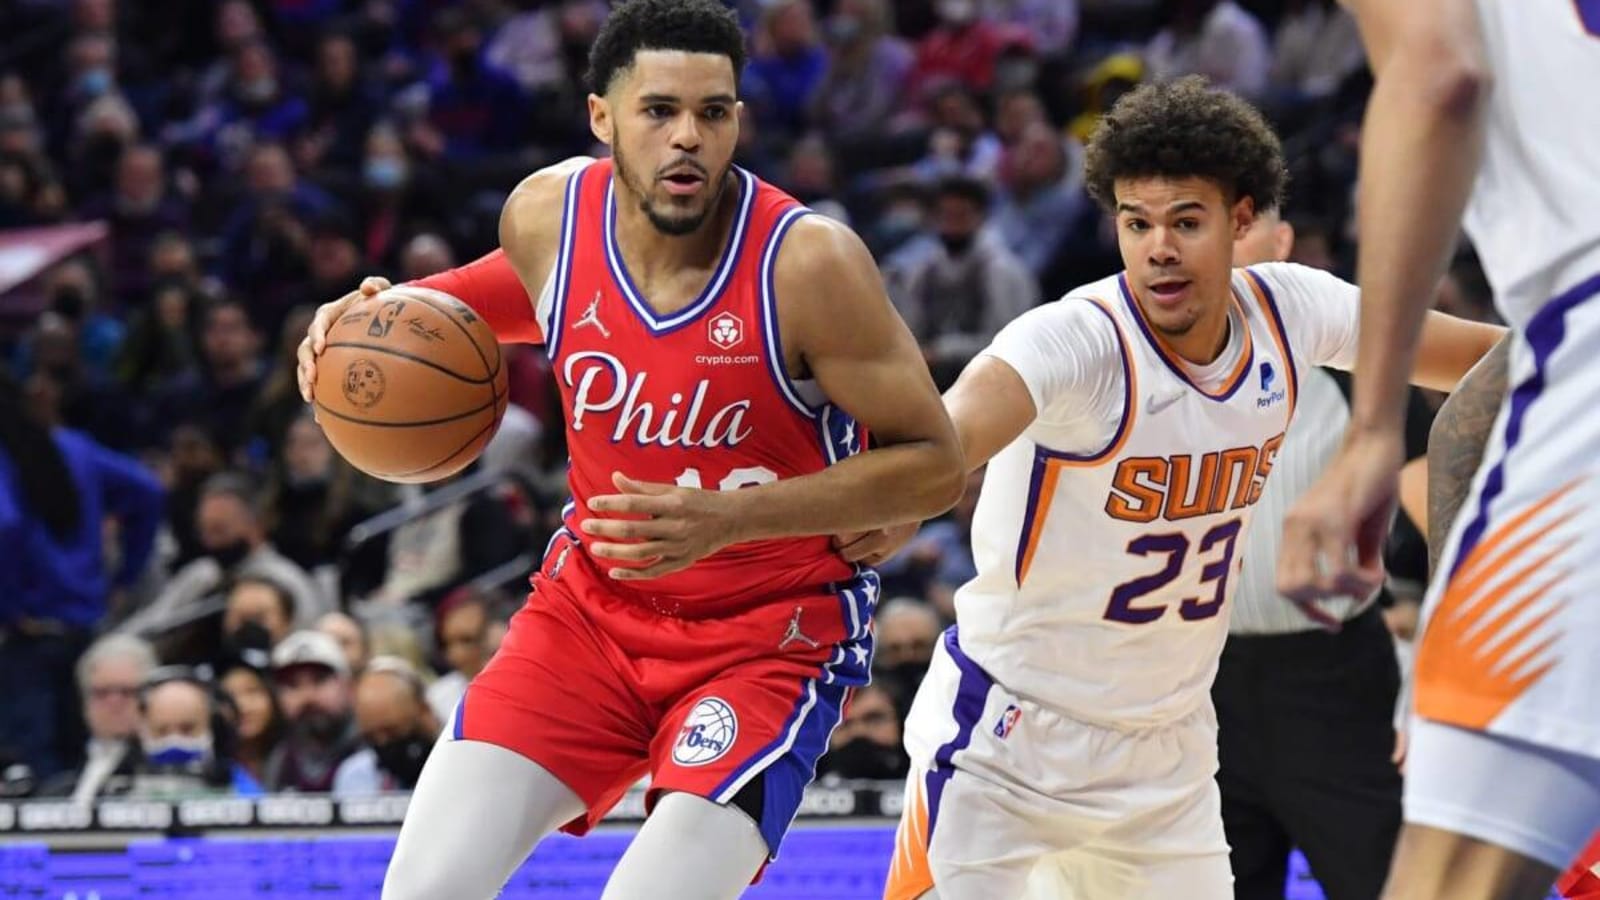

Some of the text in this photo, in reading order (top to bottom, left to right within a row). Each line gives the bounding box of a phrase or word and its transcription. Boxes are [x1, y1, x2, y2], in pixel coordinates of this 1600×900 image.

[695, 355, 759, 366] crypto.com
[563, 350, 753, 448] Phila
[1256, 388, 1285, 409] PayPal
[1104, 432, 1285, 523] SUNS
[1102, 518, 1242, 624] 23
[677, 723, 723, 752] 76ers
